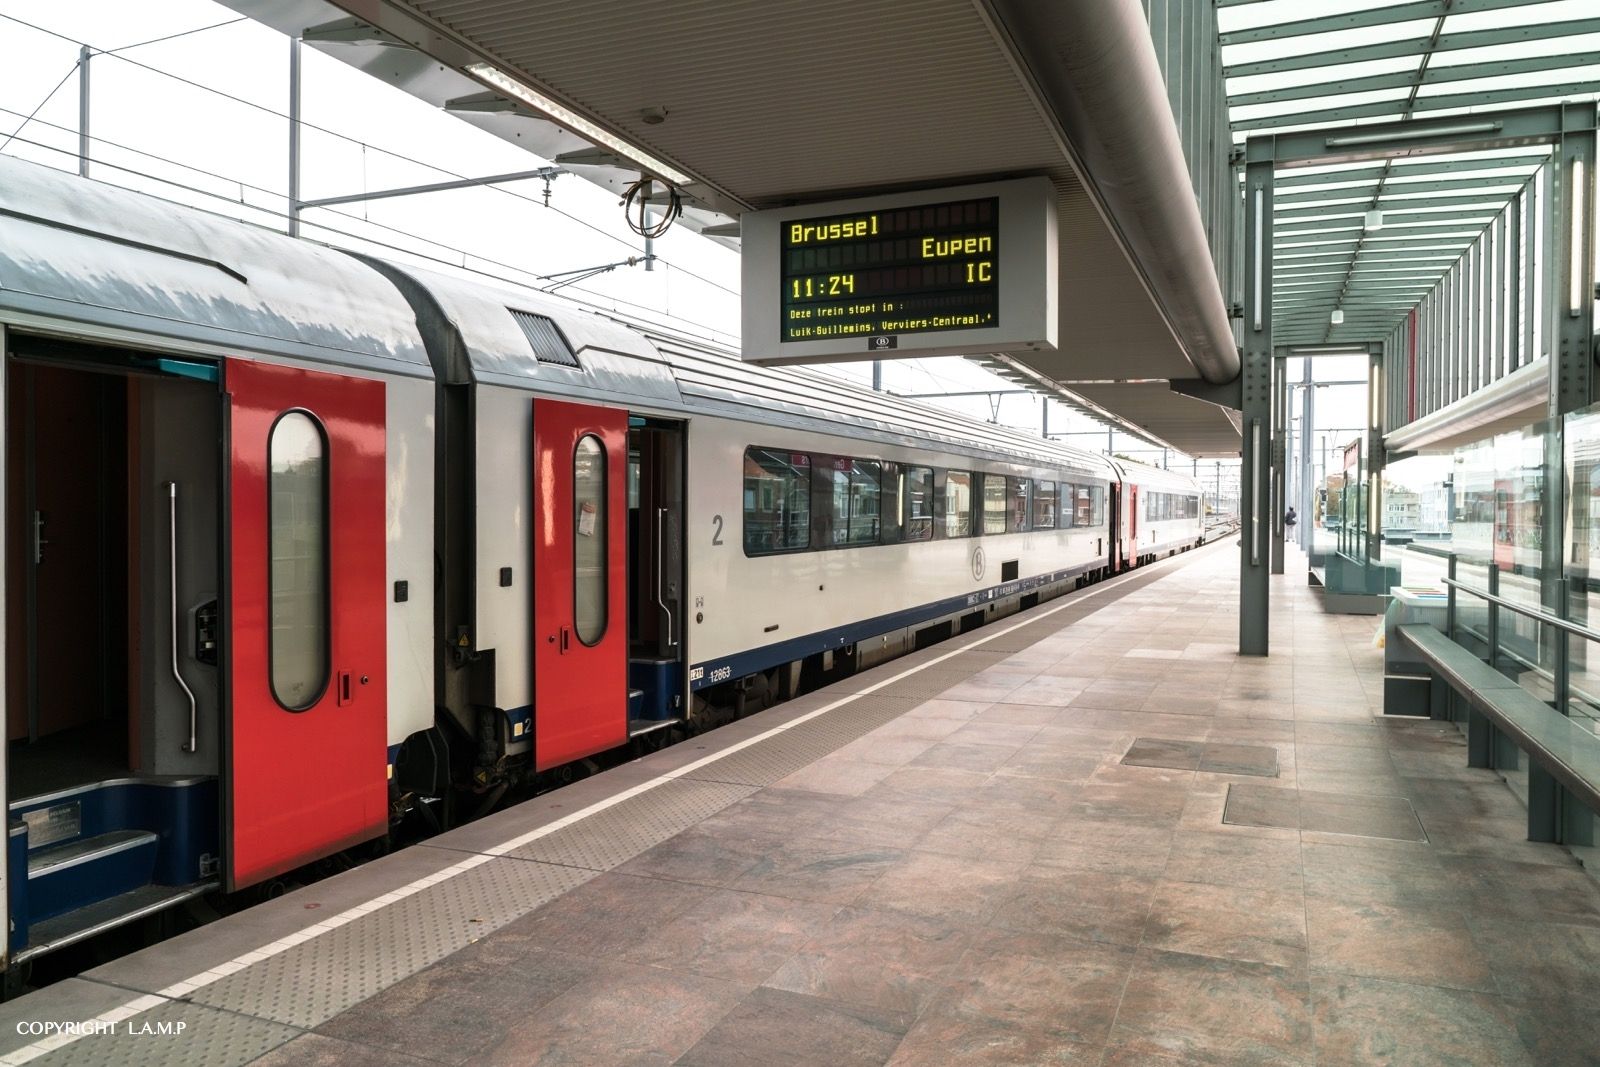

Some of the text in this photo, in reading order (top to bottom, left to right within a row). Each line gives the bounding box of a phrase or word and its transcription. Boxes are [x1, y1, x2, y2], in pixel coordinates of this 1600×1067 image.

[791, 215, 878, 243] Brussel
[922, 236, 991, 258] Eupen
[968, 262, 991, 282] IC
[793, 274, 854, 298] 11:24
[790, 309, 811, 319] Deze
[817, 307, 844, 317] trein
[849, 304, 875, 314] stopt
[712, 514, 723, 546] 2
